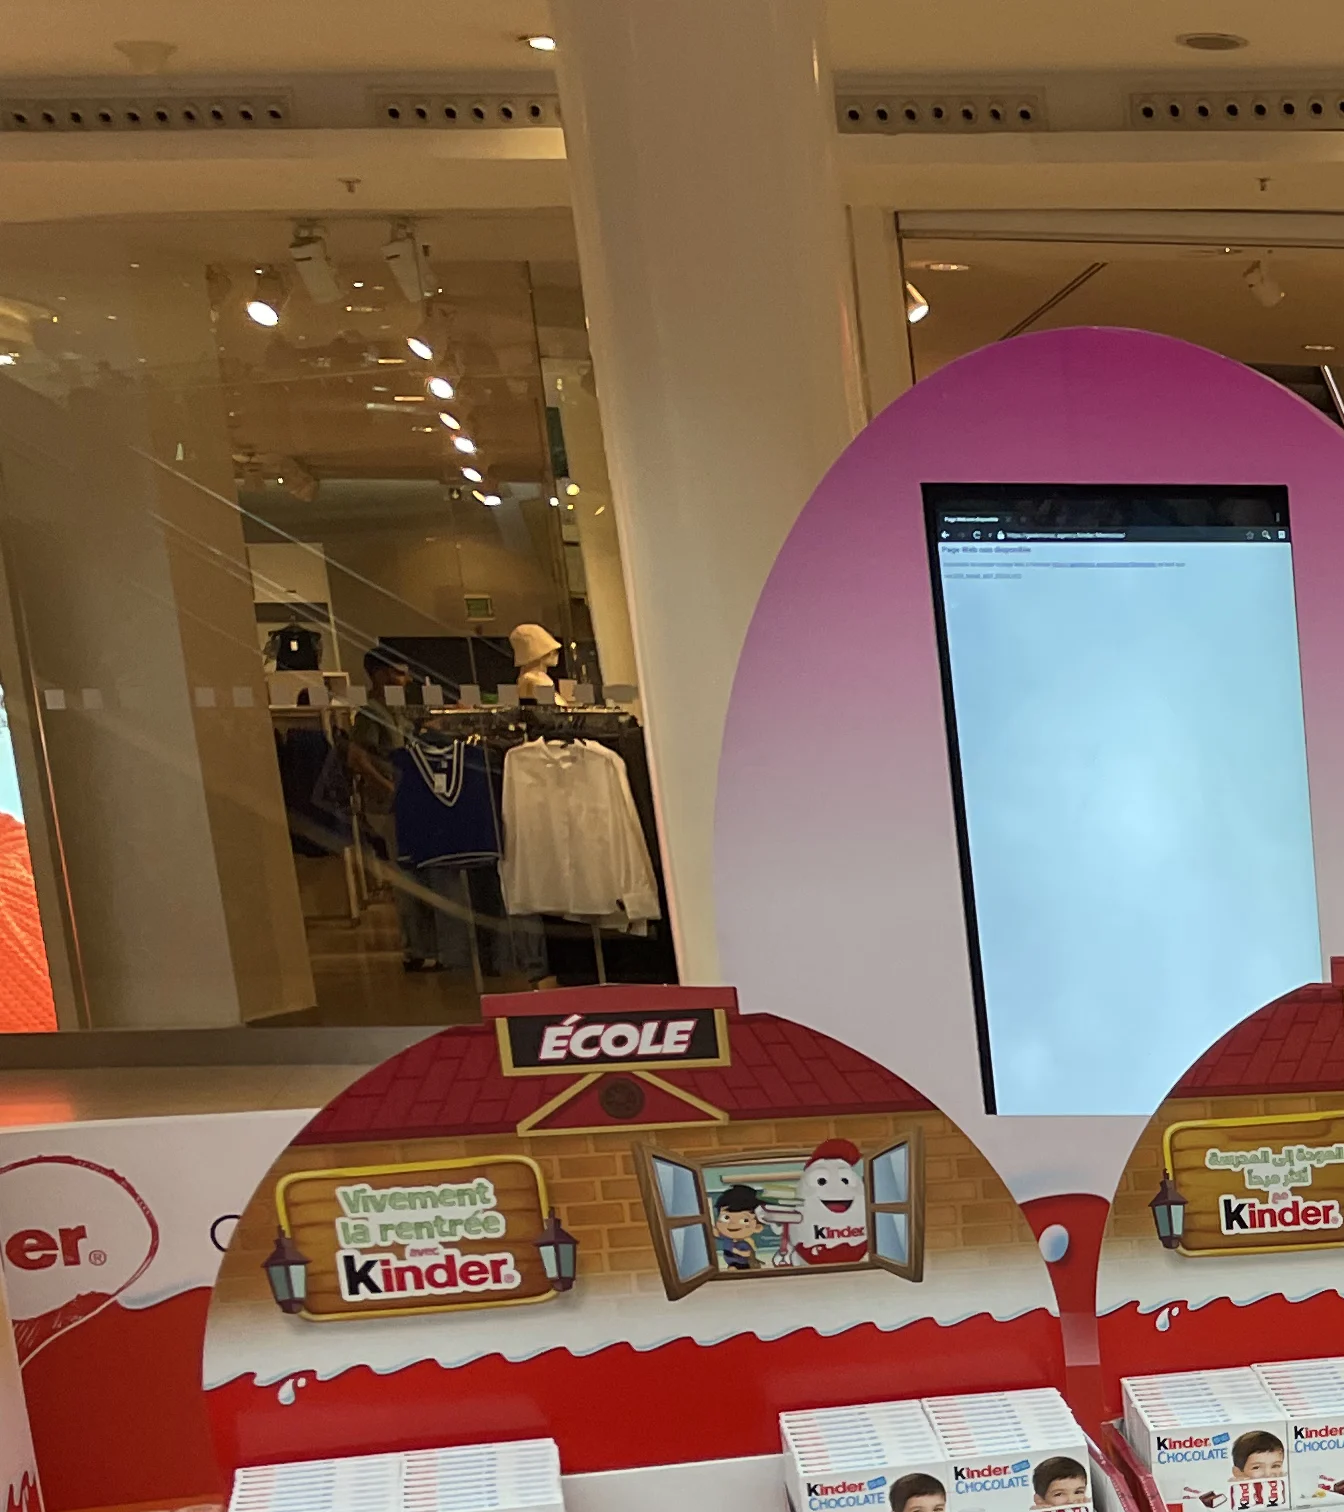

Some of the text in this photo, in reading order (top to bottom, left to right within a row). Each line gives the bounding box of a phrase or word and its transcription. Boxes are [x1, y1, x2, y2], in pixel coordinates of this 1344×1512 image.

[538, 1014, 698, 1060] ÉCOLE
[341, 1182, 492, 1214] Vivement
[1223, 1199, 1334, 1230] Kinder
[340, 1211, 500, 1245] la rentrée
[814, 1225, 865, 1240] Kinder
[343, 1254, 508, 1295] Kinder
[1157, 1435, 1211, 1450] Kinder
[1158, 1448, 1228, 1465] CHOCOLATE
[954, 1462, 1010, 1480] Kinder
[806, 1480, 866, 1496] Kinder
[956, 1474, 1029, 1494] CHOCOLATE
[809, 1491, 885, 1511] CHOCOLATE
